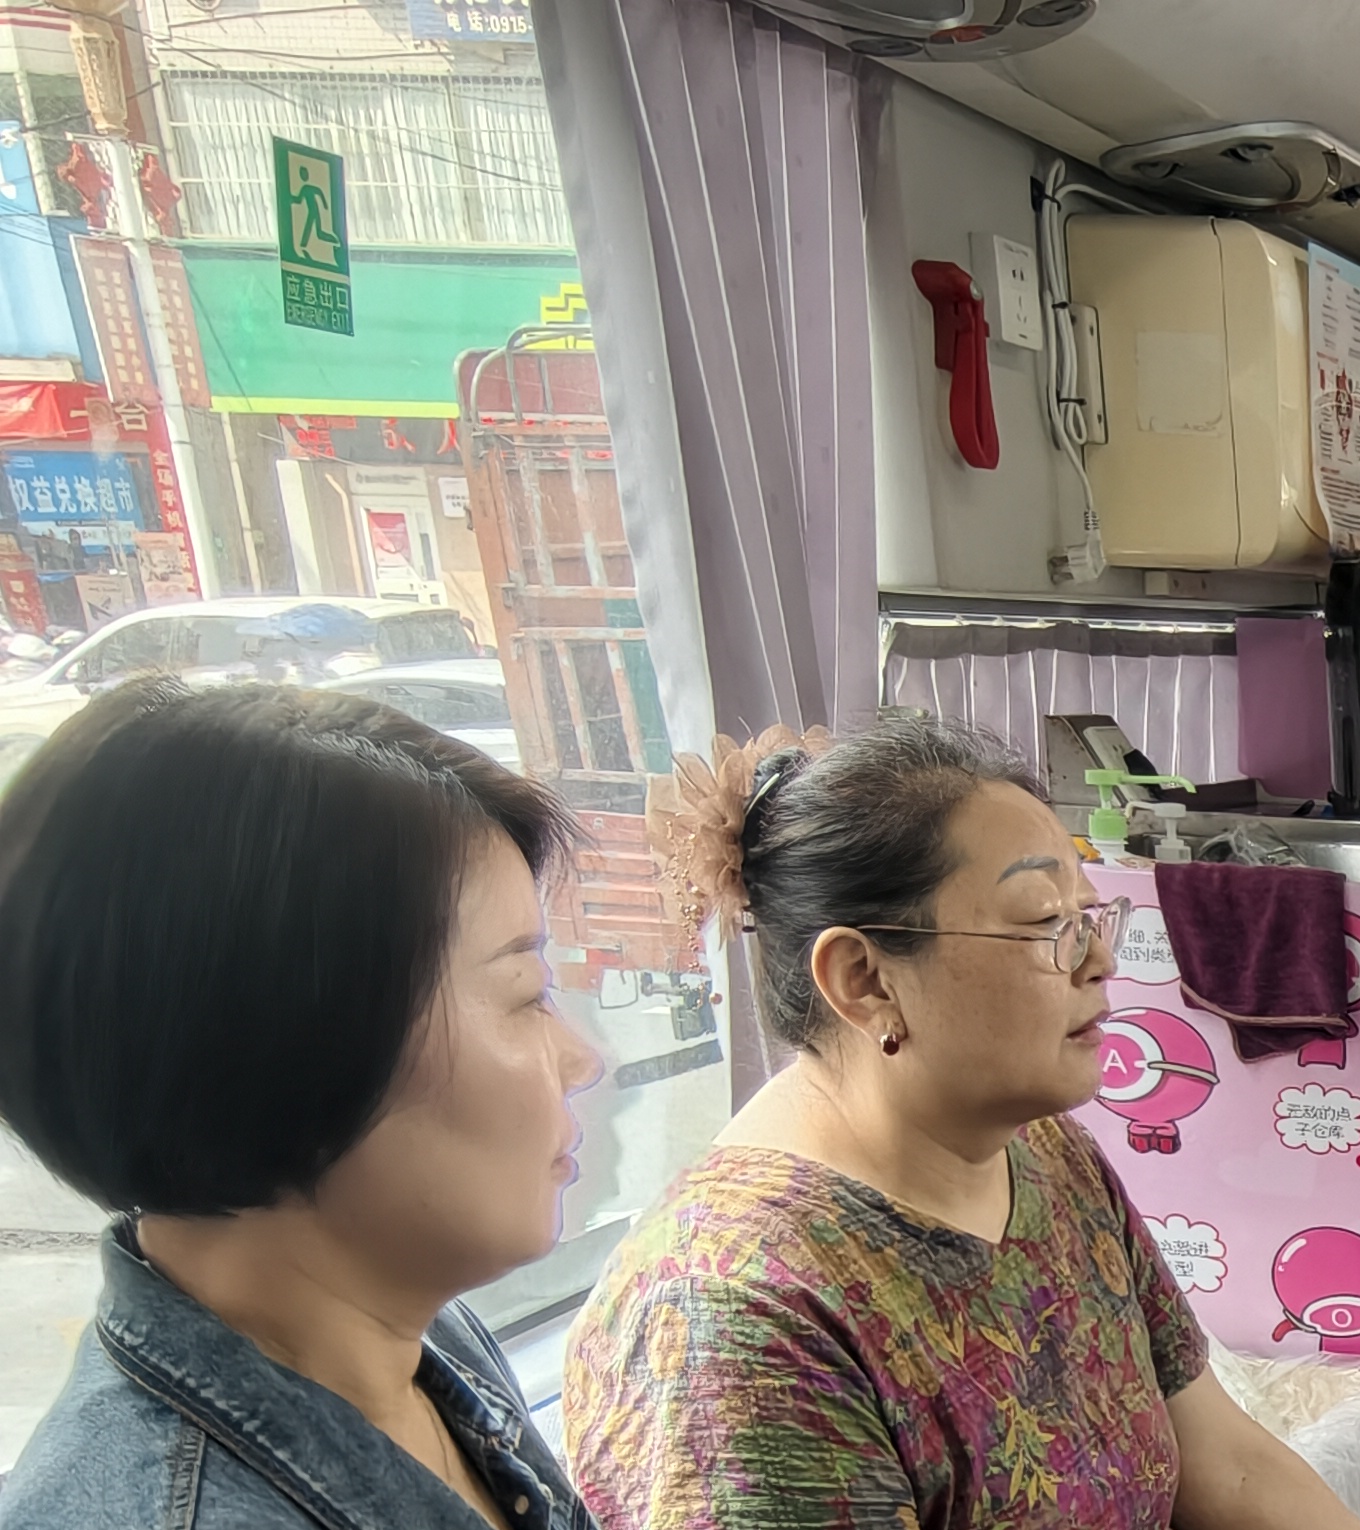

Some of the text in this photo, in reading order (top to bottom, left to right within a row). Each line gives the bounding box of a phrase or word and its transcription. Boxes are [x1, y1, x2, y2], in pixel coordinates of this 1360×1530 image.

[286, 275, 349, 310] 应急出口
[1102, 1048, 1128, 1074] A
